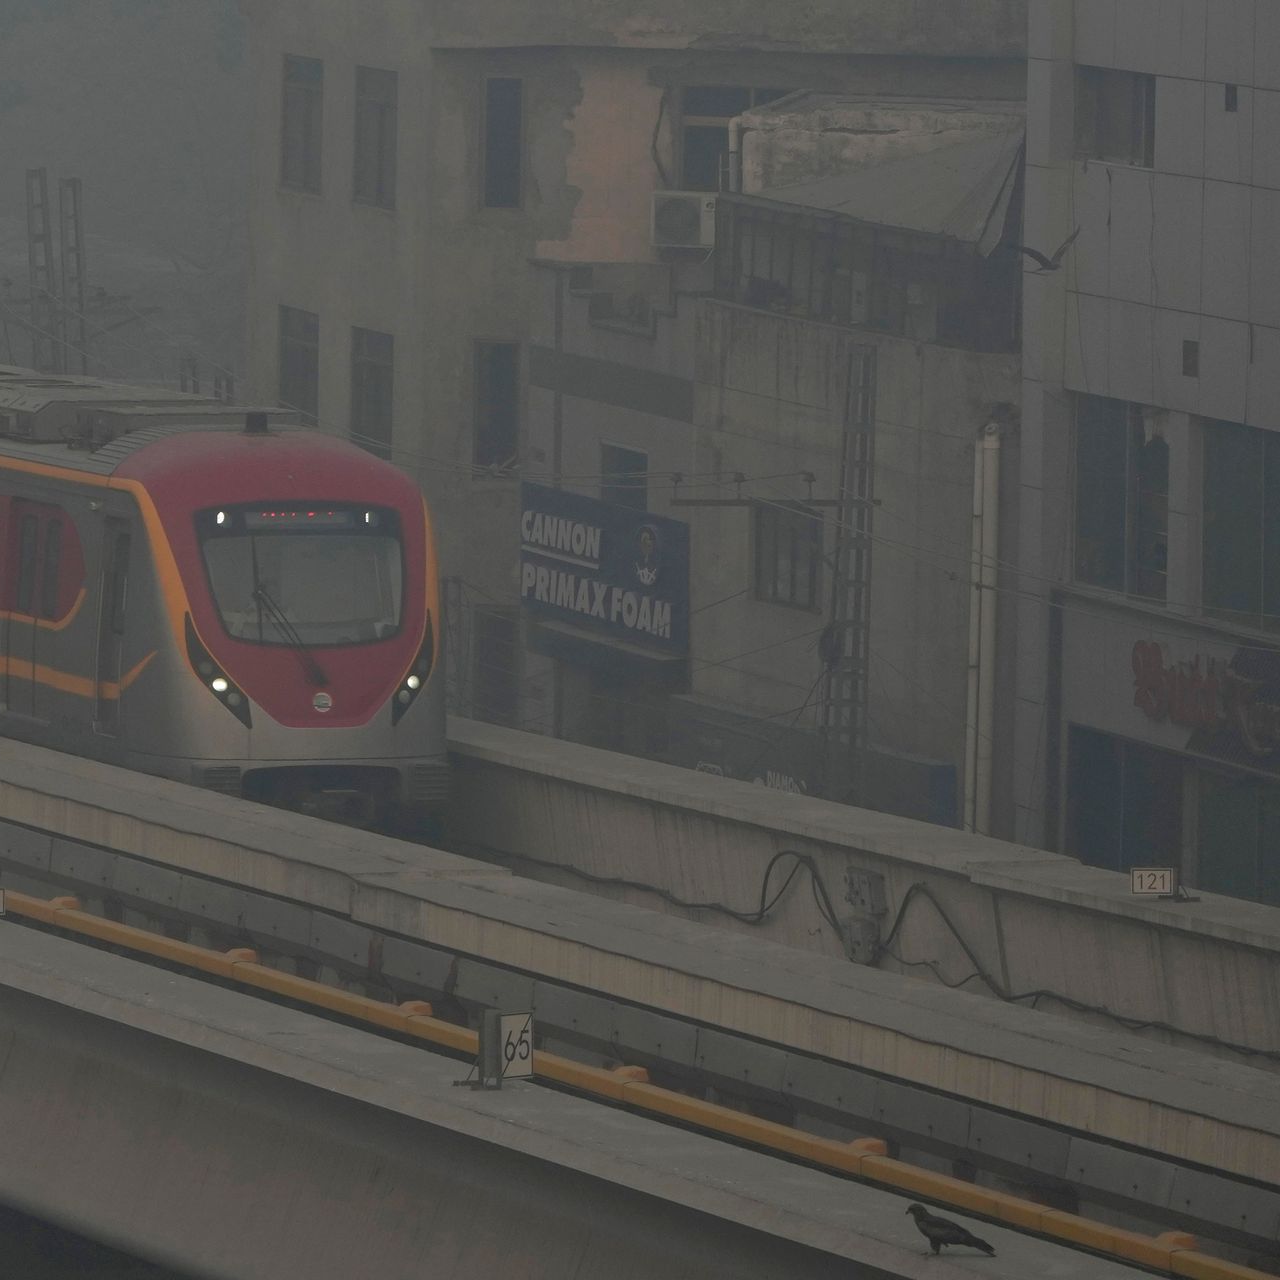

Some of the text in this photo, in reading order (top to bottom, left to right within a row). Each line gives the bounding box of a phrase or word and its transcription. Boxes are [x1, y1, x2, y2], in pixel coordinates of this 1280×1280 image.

[521, 510, 601, 559] CANNON
[521, 562, 672, 639] PRIMAX FOAM
[1137, 872, 1166, 890] 121
[504, 1029, 530, 1062] 65
